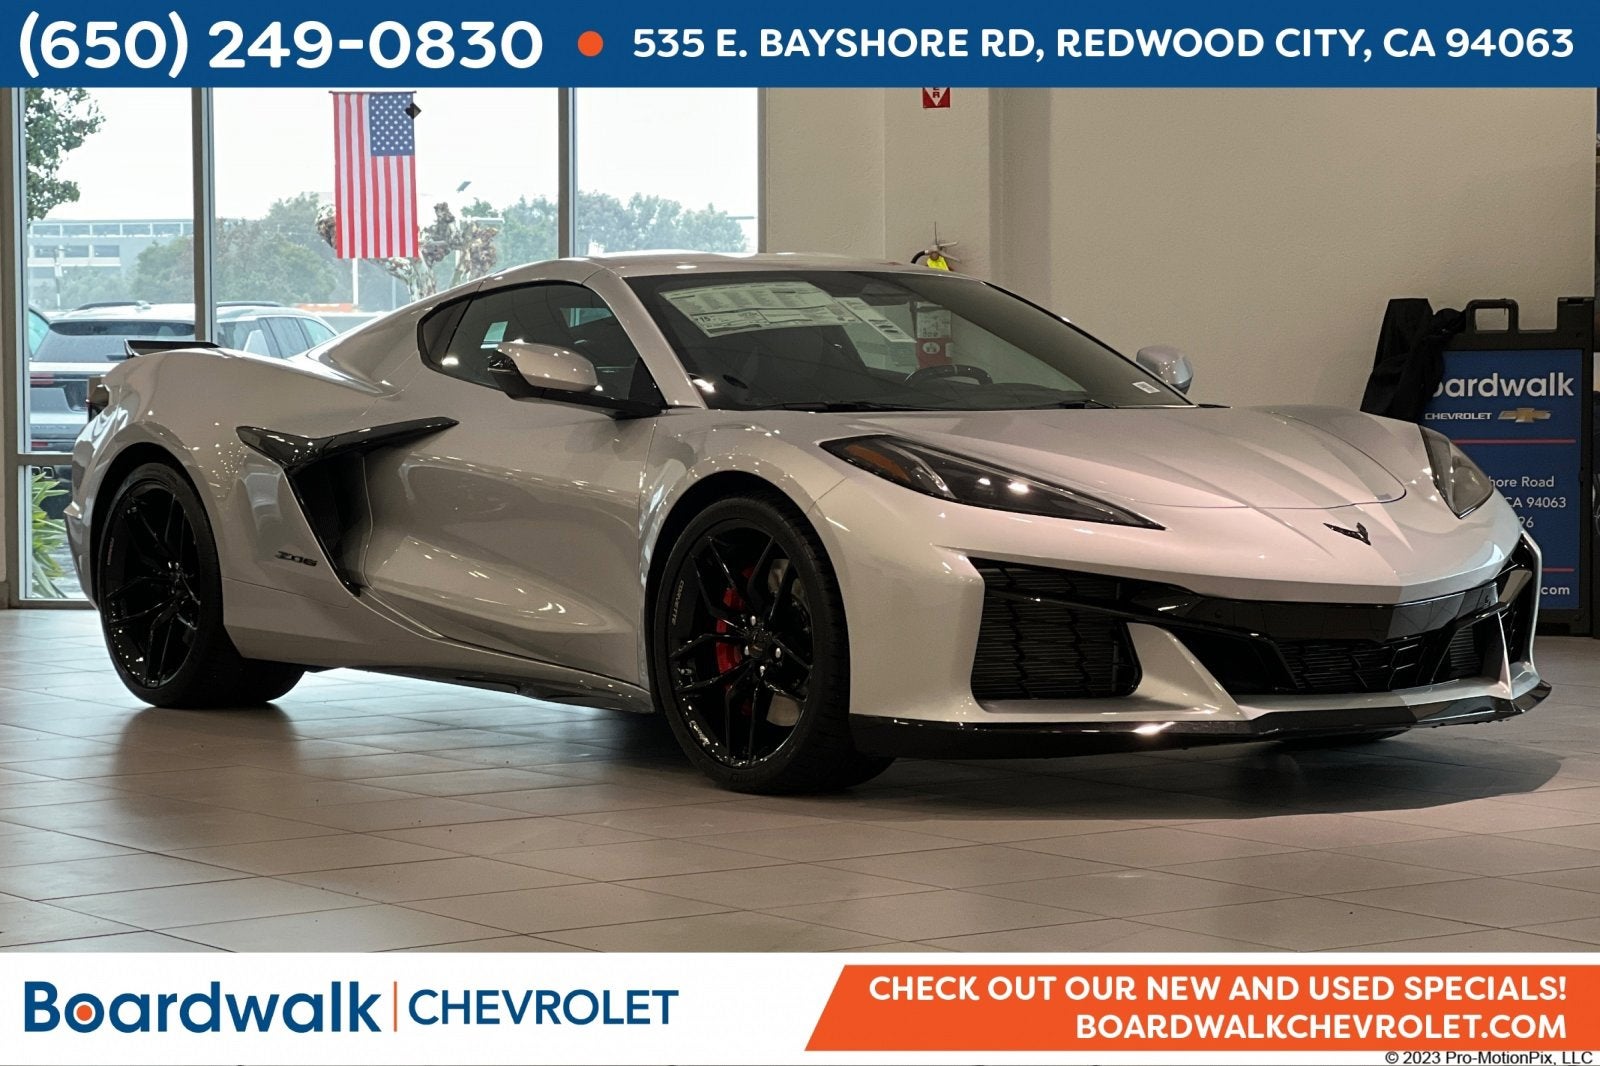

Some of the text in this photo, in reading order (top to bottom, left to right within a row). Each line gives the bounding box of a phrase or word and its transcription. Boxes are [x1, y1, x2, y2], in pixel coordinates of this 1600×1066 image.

[1425, 412, 1493, 420] CHEVROLET
[1522, 476, 1554, 487] Road
[1527, 497, 1567, 508] 94063
